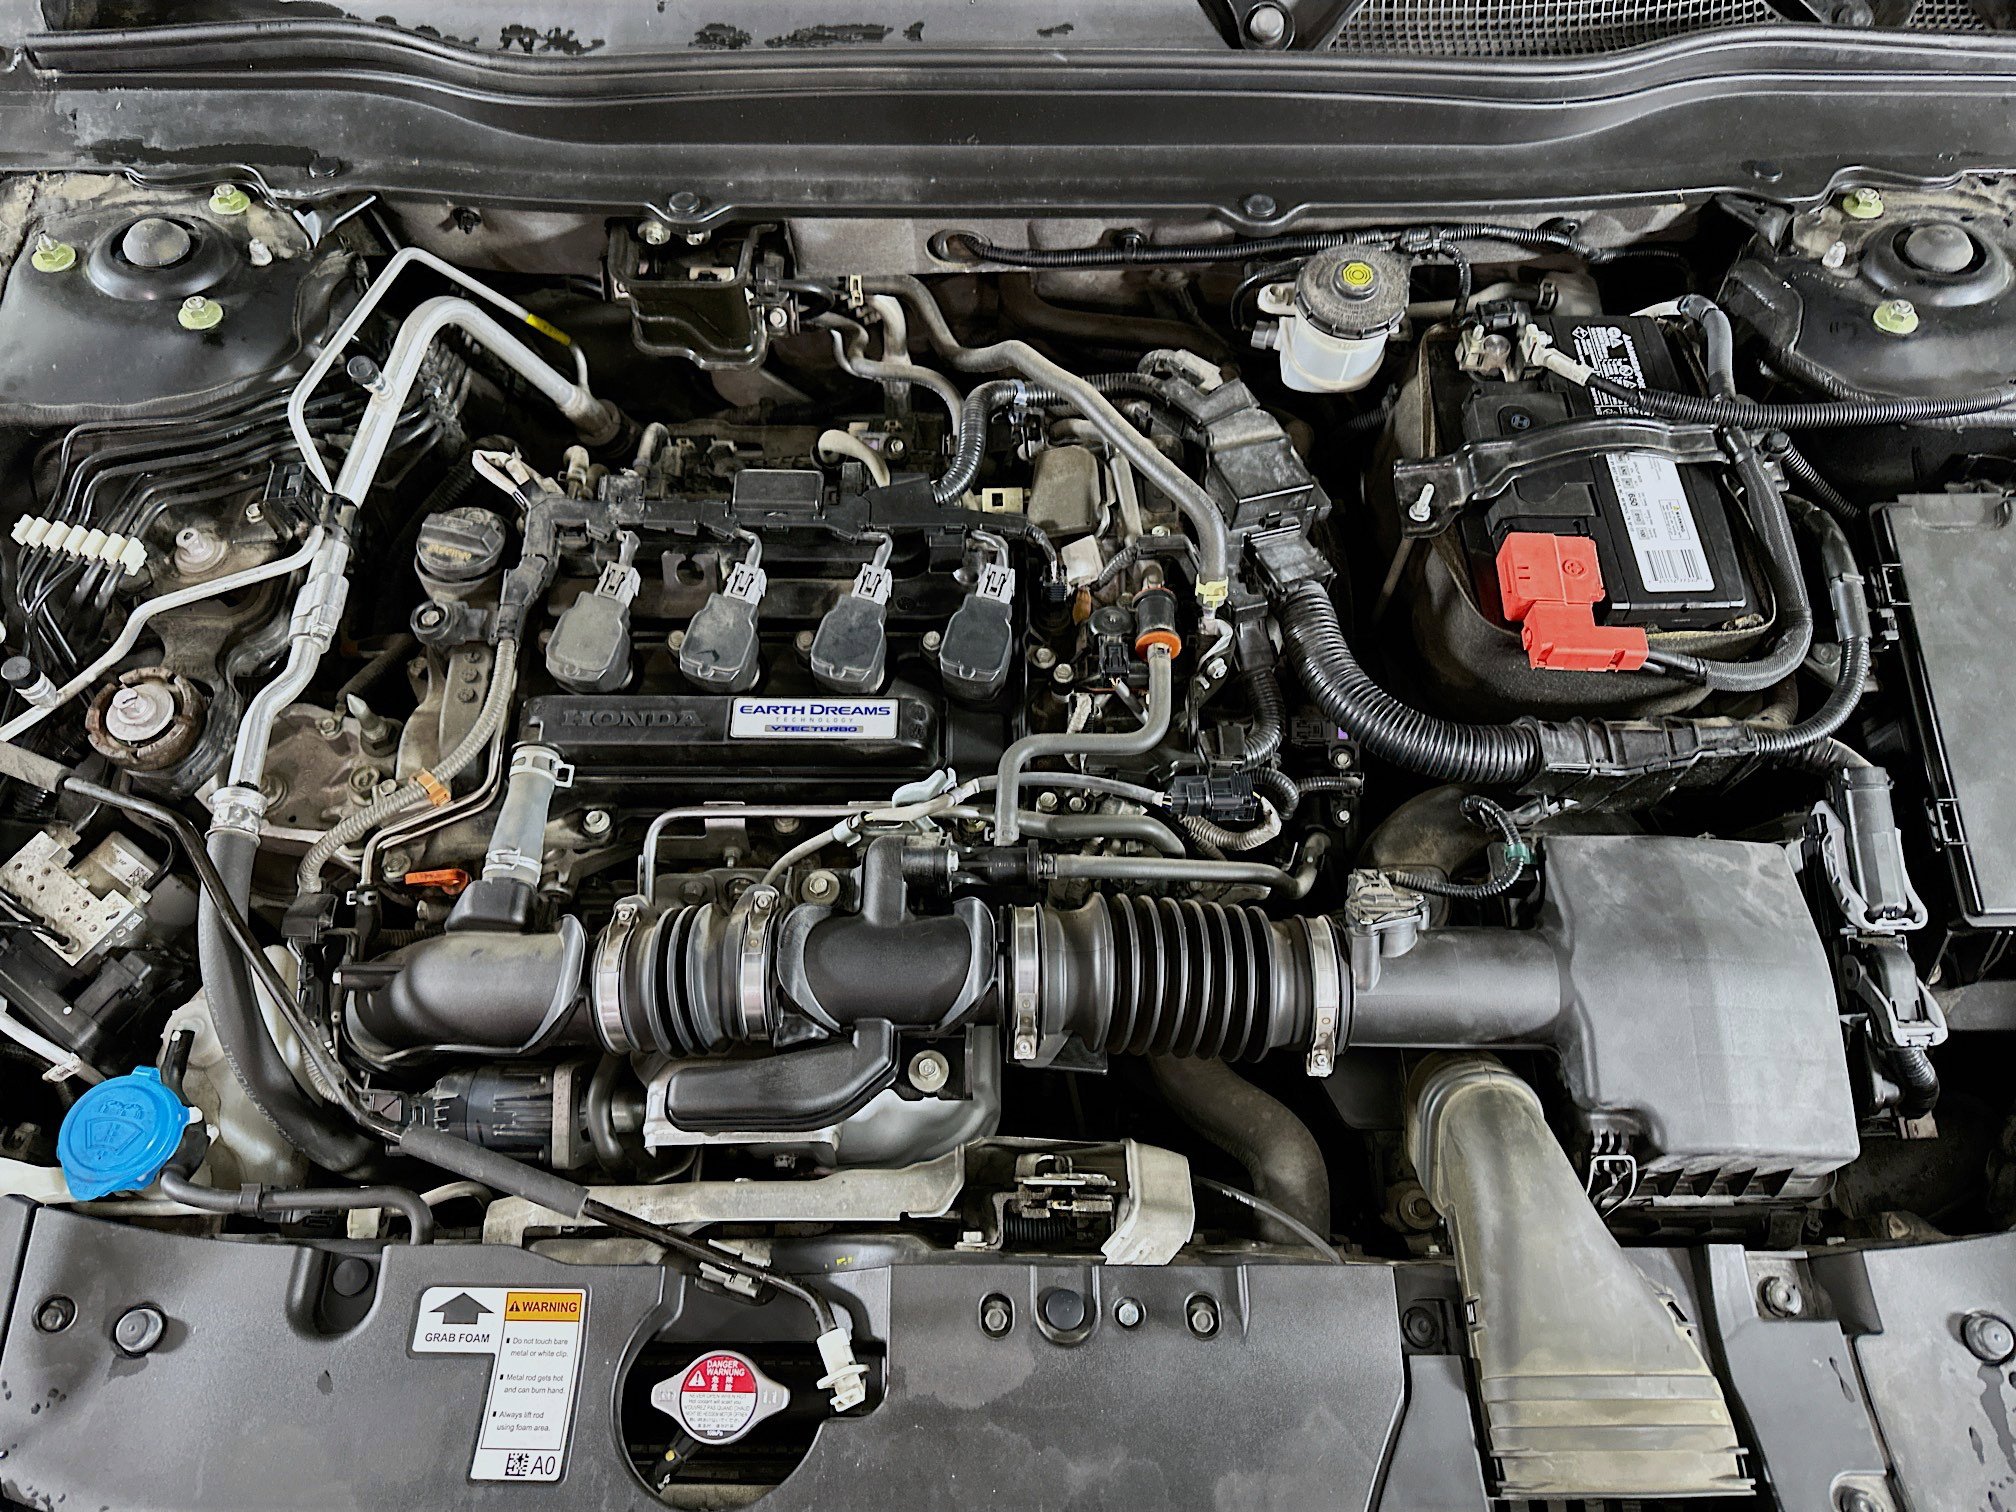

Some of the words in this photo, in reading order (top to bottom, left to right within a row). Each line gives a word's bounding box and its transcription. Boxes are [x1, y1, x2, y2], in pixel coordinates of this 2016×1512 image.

[1628, 493, 1638, 506] 650
[740, 705, 805, 715] EARTH
[810, 704, 891, 716] DREAMS
[562, 709, 705, 727] HONDA
[522, 1301, 577, 1313] WARNING
[425, 1333, 455, 1343] GRAB
[458, 1333, 490, 1343] FOAM
[513, 1337, 522, 1345] Do
[556, 1350, 569, 1358] clip.
[706, 1360, 738, 1369] DANGER
[706, 1368, 745, 1376] WARNUNG
[537, 1375, 552, 1383] gets
[498, 1411, 523, 1419] Always
[533, 1411, 544, 1419] rod
[496, 1423, 515, 1432] using
[516, 1423, 532, 1431] foam
[530, 1456, 556, 1475] A0
